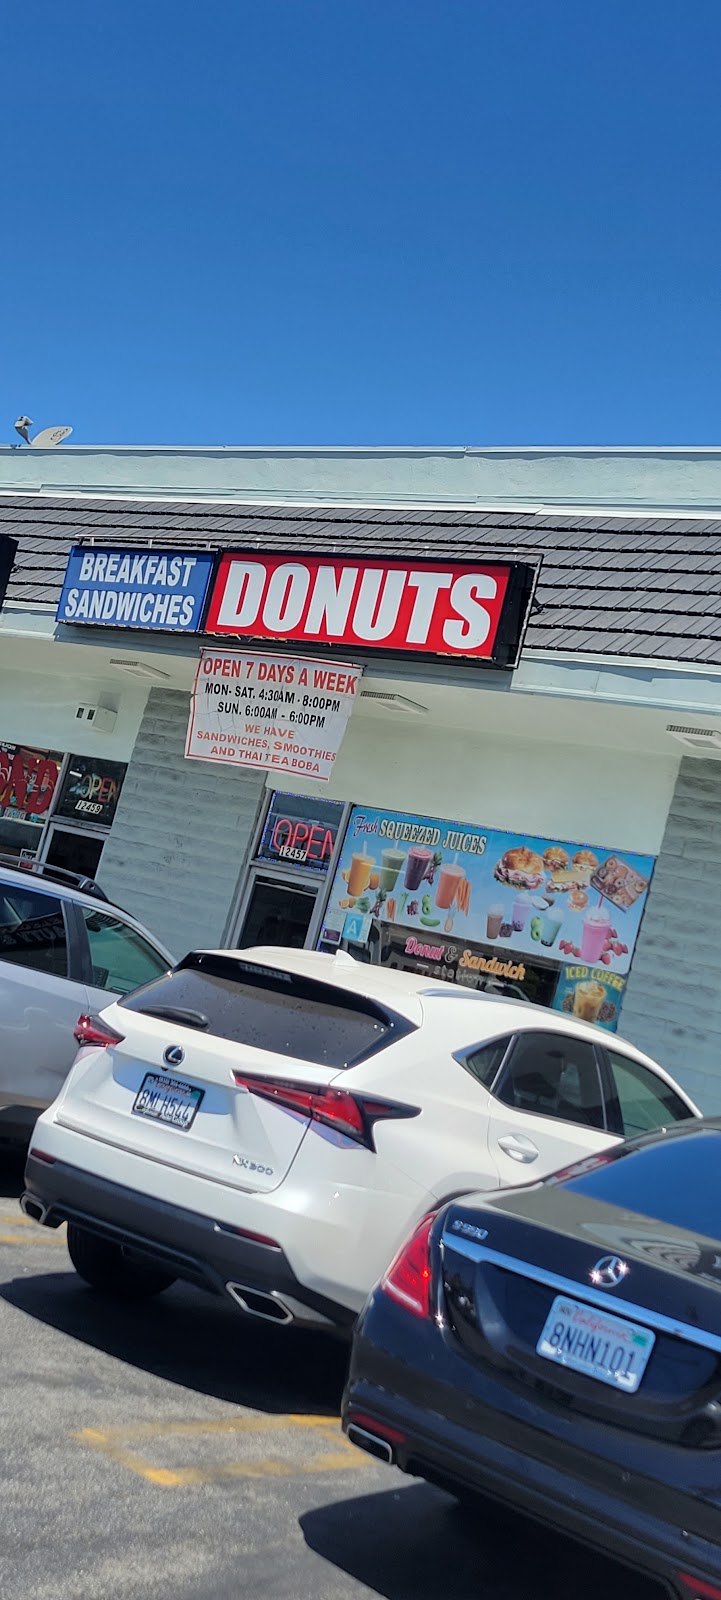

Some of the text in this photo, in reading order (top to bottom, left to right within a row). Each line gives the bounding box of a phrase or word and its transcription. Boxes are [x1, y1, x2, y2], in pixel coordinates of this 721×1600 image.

[79, 552, 197, 588] BREAKFAST
[64, 588, 195, 626] SANDWICHES
[216, 560, 498, 649] DONUTS
[203, 657, 359, 695] OPEN 7 DAYS A WEEK
[204, 682, 232, 696] MON-
[234, 685, 256, 700] SAT.
[258, 688, 296, 705] 4:30AM
[302, 694, 341, 713] 8:00PM
[217, 701, 242, 716] SUN.
[245, 705, 278, 720] 6:00AM
[289, 711, 326, 728] 6:00PM
[197, 730, 337, 762] SANDWICHES, SMOOTHIES
[245, 723, 296, 739] WE HAVE
[210, 745, 320, 773] AND THAI TEA BOBA
[81, 774, 118, 803] OPEN
[76, 801, 102, 813] 12459
[273, 818, 334, 859] OPEN
[353, 815, 487, 855] Fresh SQUEEZED JUICES
[280, 846, 307, 860] 12457
[346, 920, 358, 935] A
[404, 936, 526, 981] Donut & Sandwich
[565, 966, 626, 992] ICED COFFEE
[549, 1322, 635, 1380] 8NHN101
